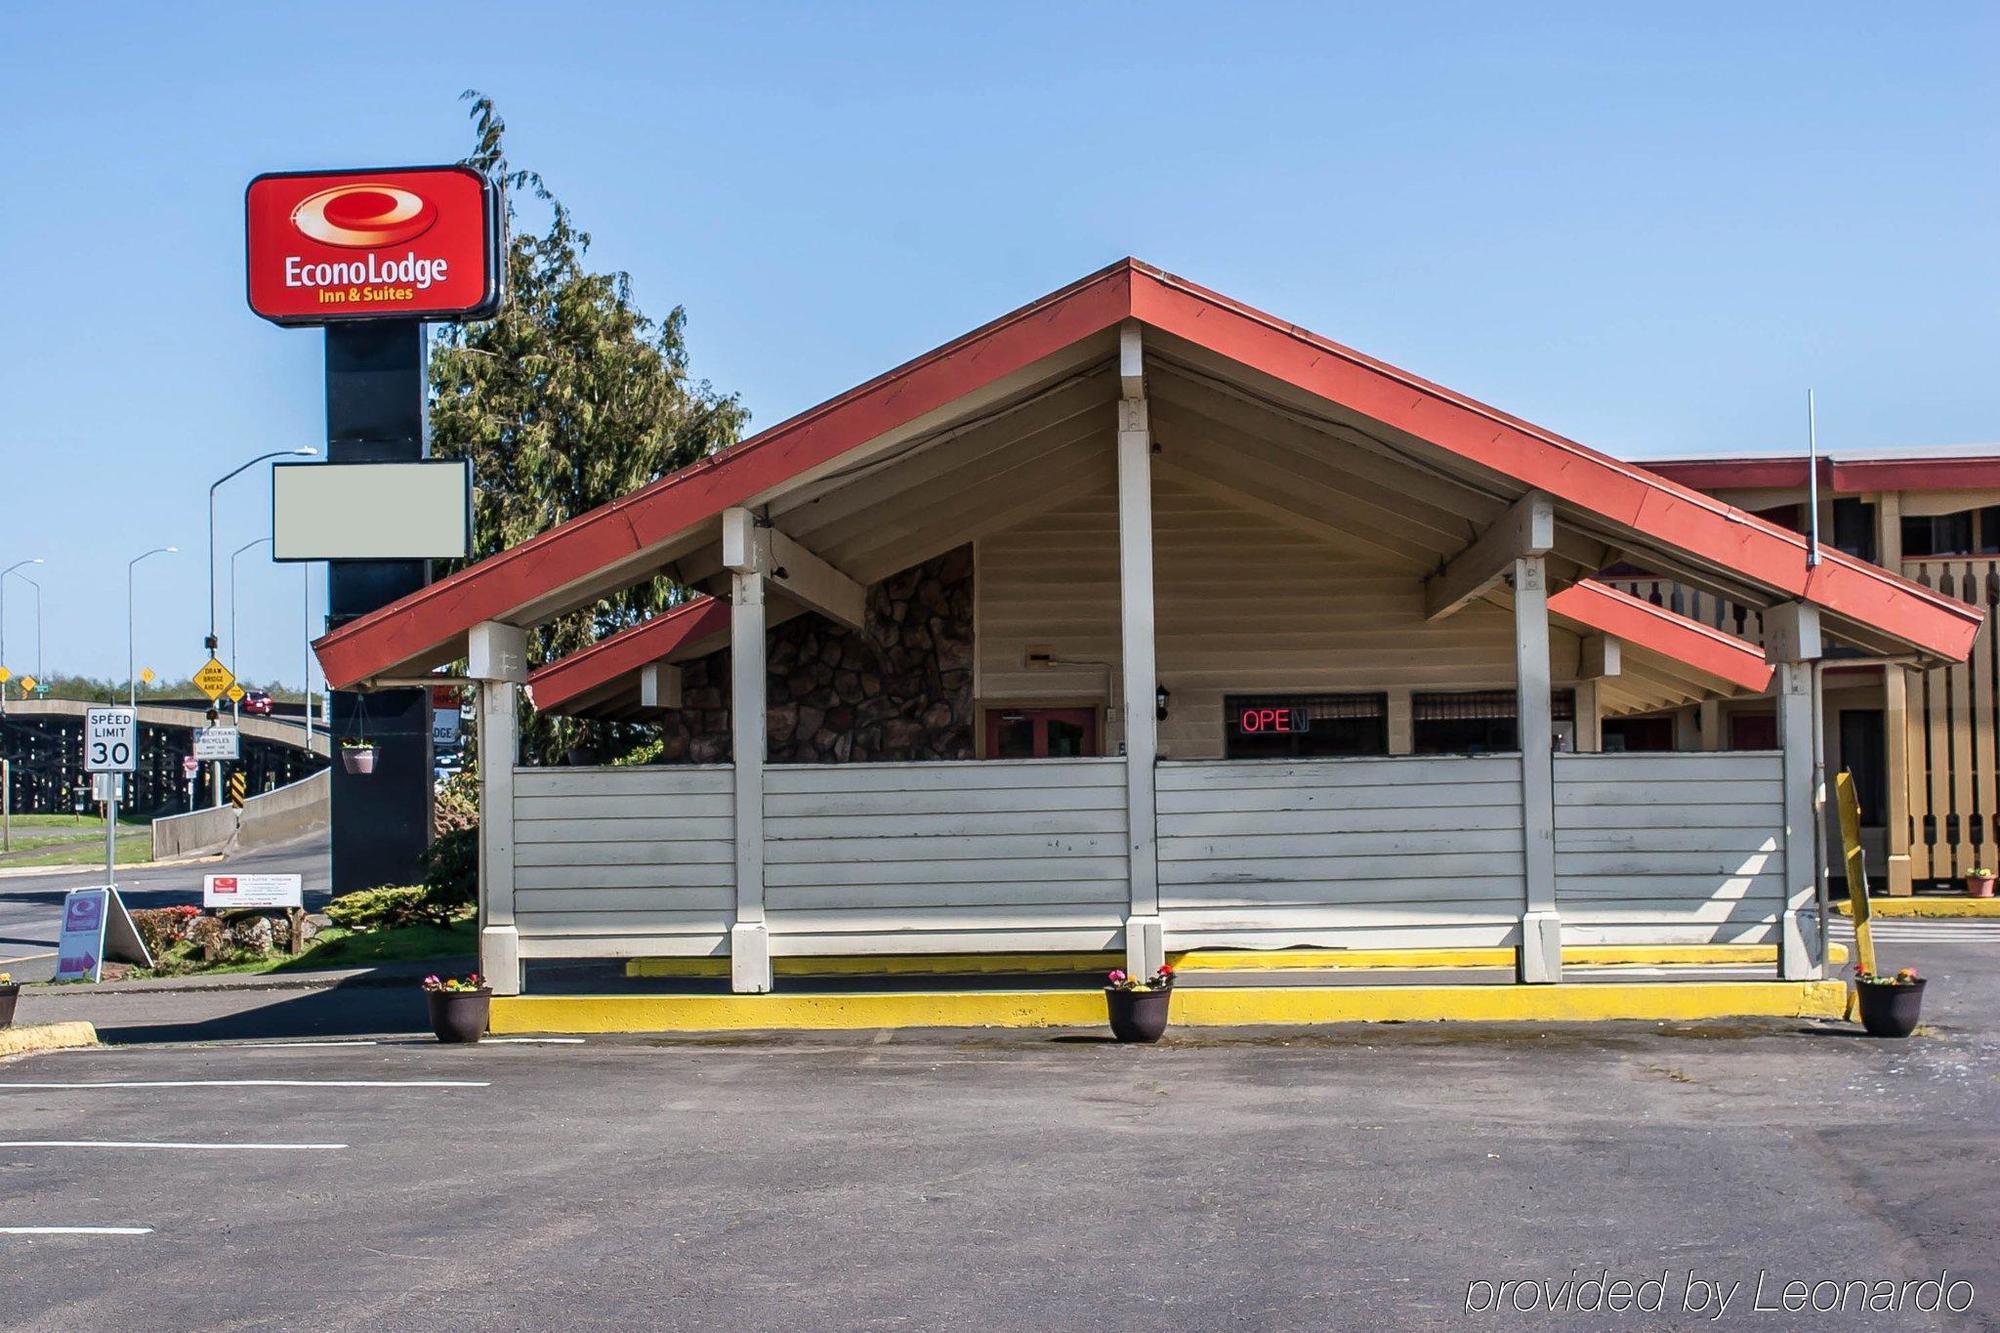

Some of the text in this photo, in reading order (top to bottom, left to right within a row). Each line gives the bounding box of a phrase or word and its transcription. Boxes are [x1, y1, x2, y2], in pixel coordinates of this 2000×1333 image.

[319, 285, 414, 303] Inn & Suites
[91, 715, 131, 724] SPEED
[1243, 709, 1306, 731] OPEN
[95, 728, 126, 737] LIMIT
[91, 742, 129, 764] 30
